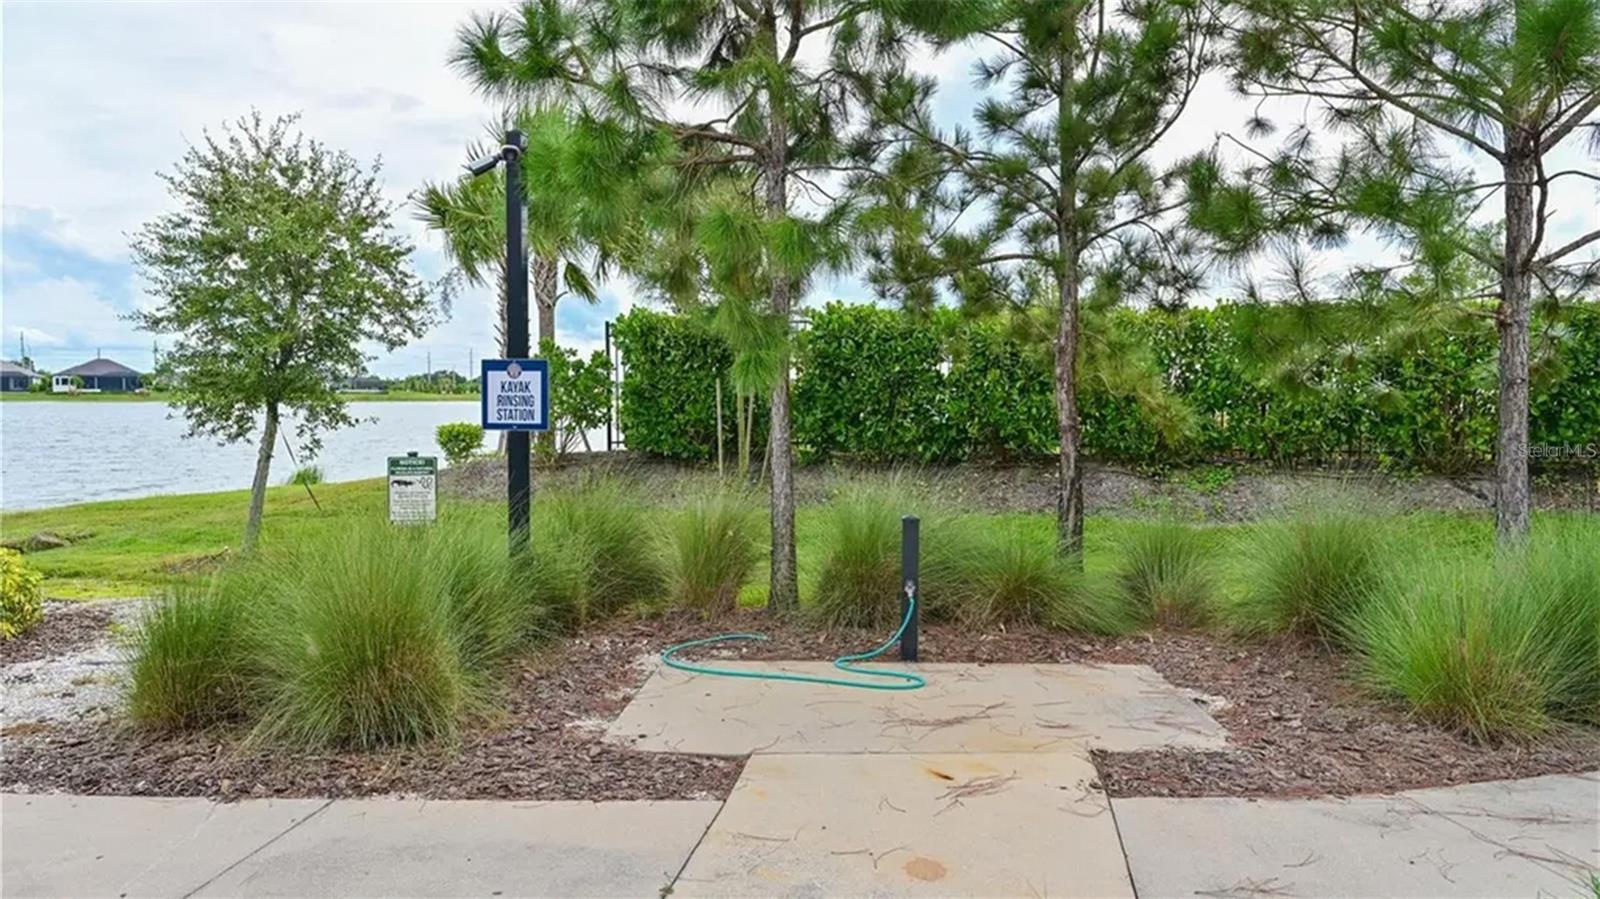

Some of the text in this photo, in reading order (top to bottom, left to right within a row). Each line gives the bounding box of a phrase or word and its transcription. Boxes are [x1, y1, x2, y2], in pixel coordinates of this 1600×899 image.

[500, 381, 531, 393] KAYAK
[496, 394, 535, 407] RINSING
[496, 408, 535, 421] STATION
